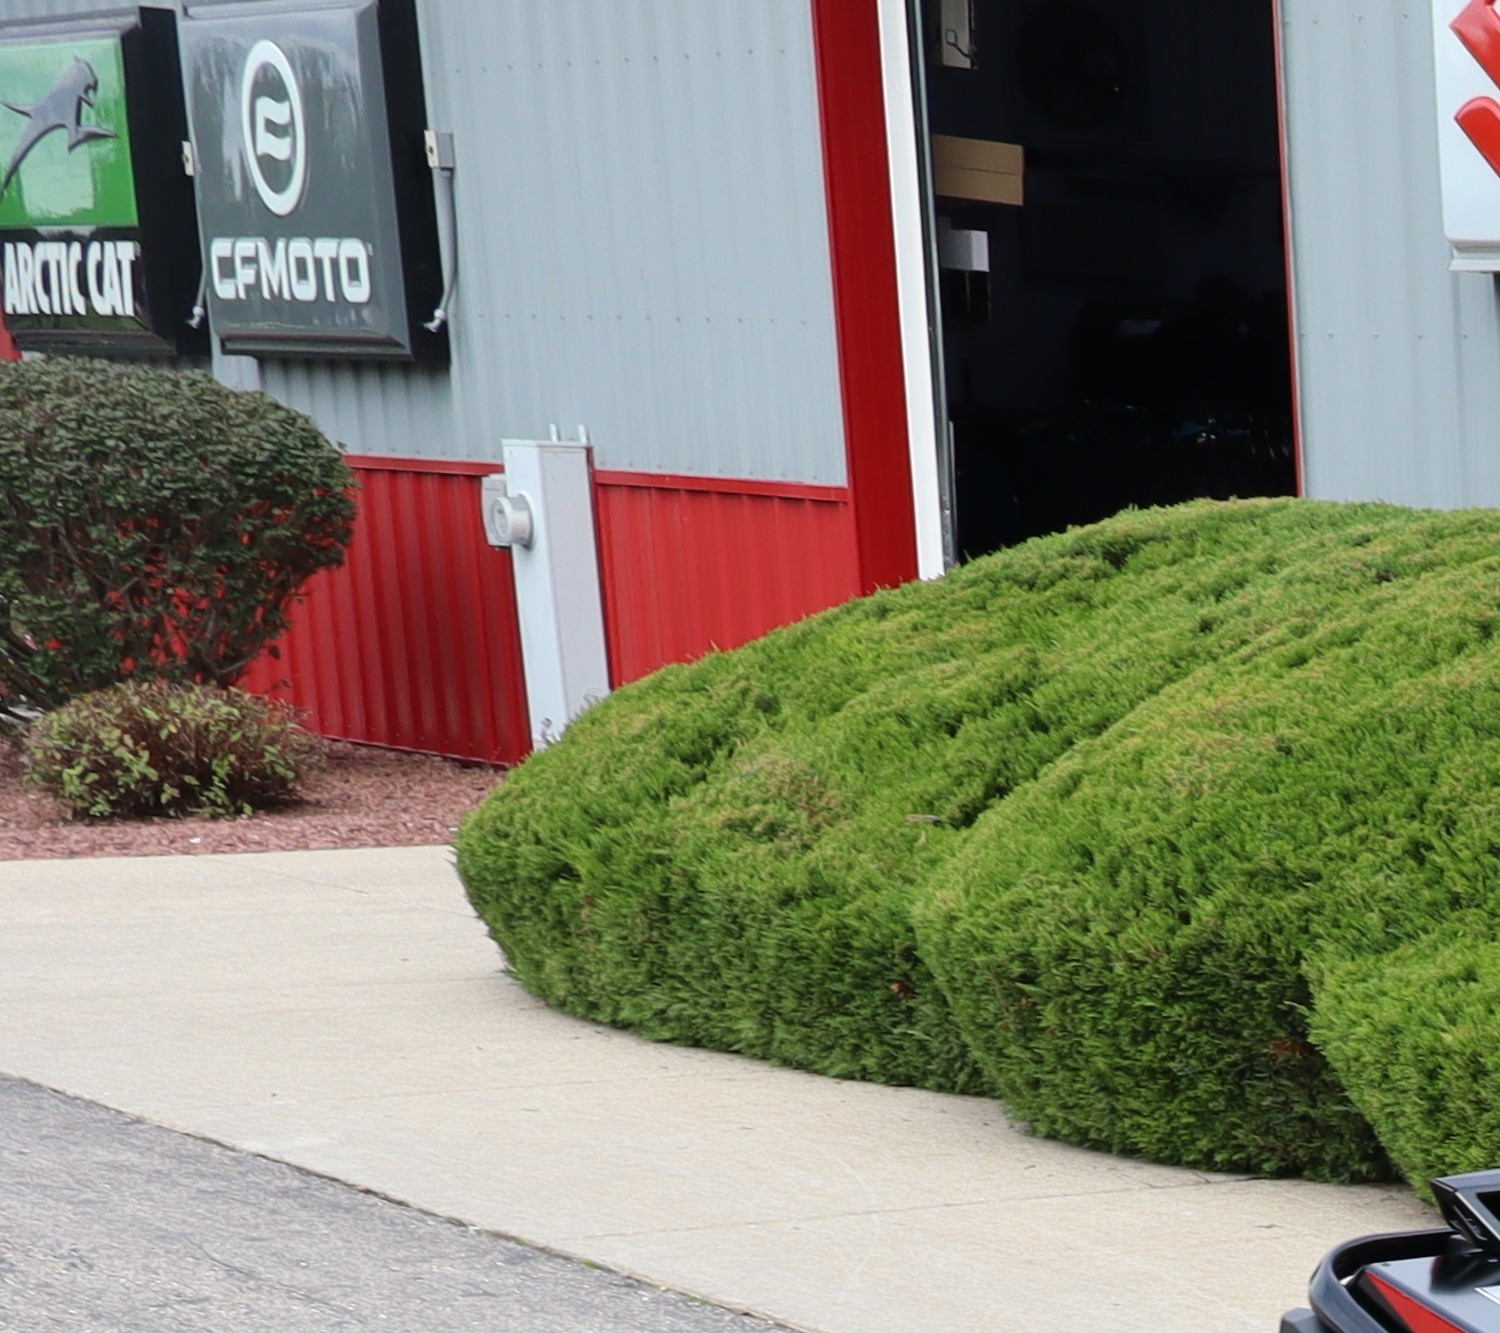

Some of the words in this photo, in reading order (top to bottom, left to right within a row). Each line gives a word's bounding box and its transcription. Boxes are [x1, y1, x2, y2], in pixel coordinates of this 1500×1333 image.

[4, 240, 88, 316] ARCTIC
[87, 240, 137, 318] CAT
[211, 237, 371, 304] CFMOTO
